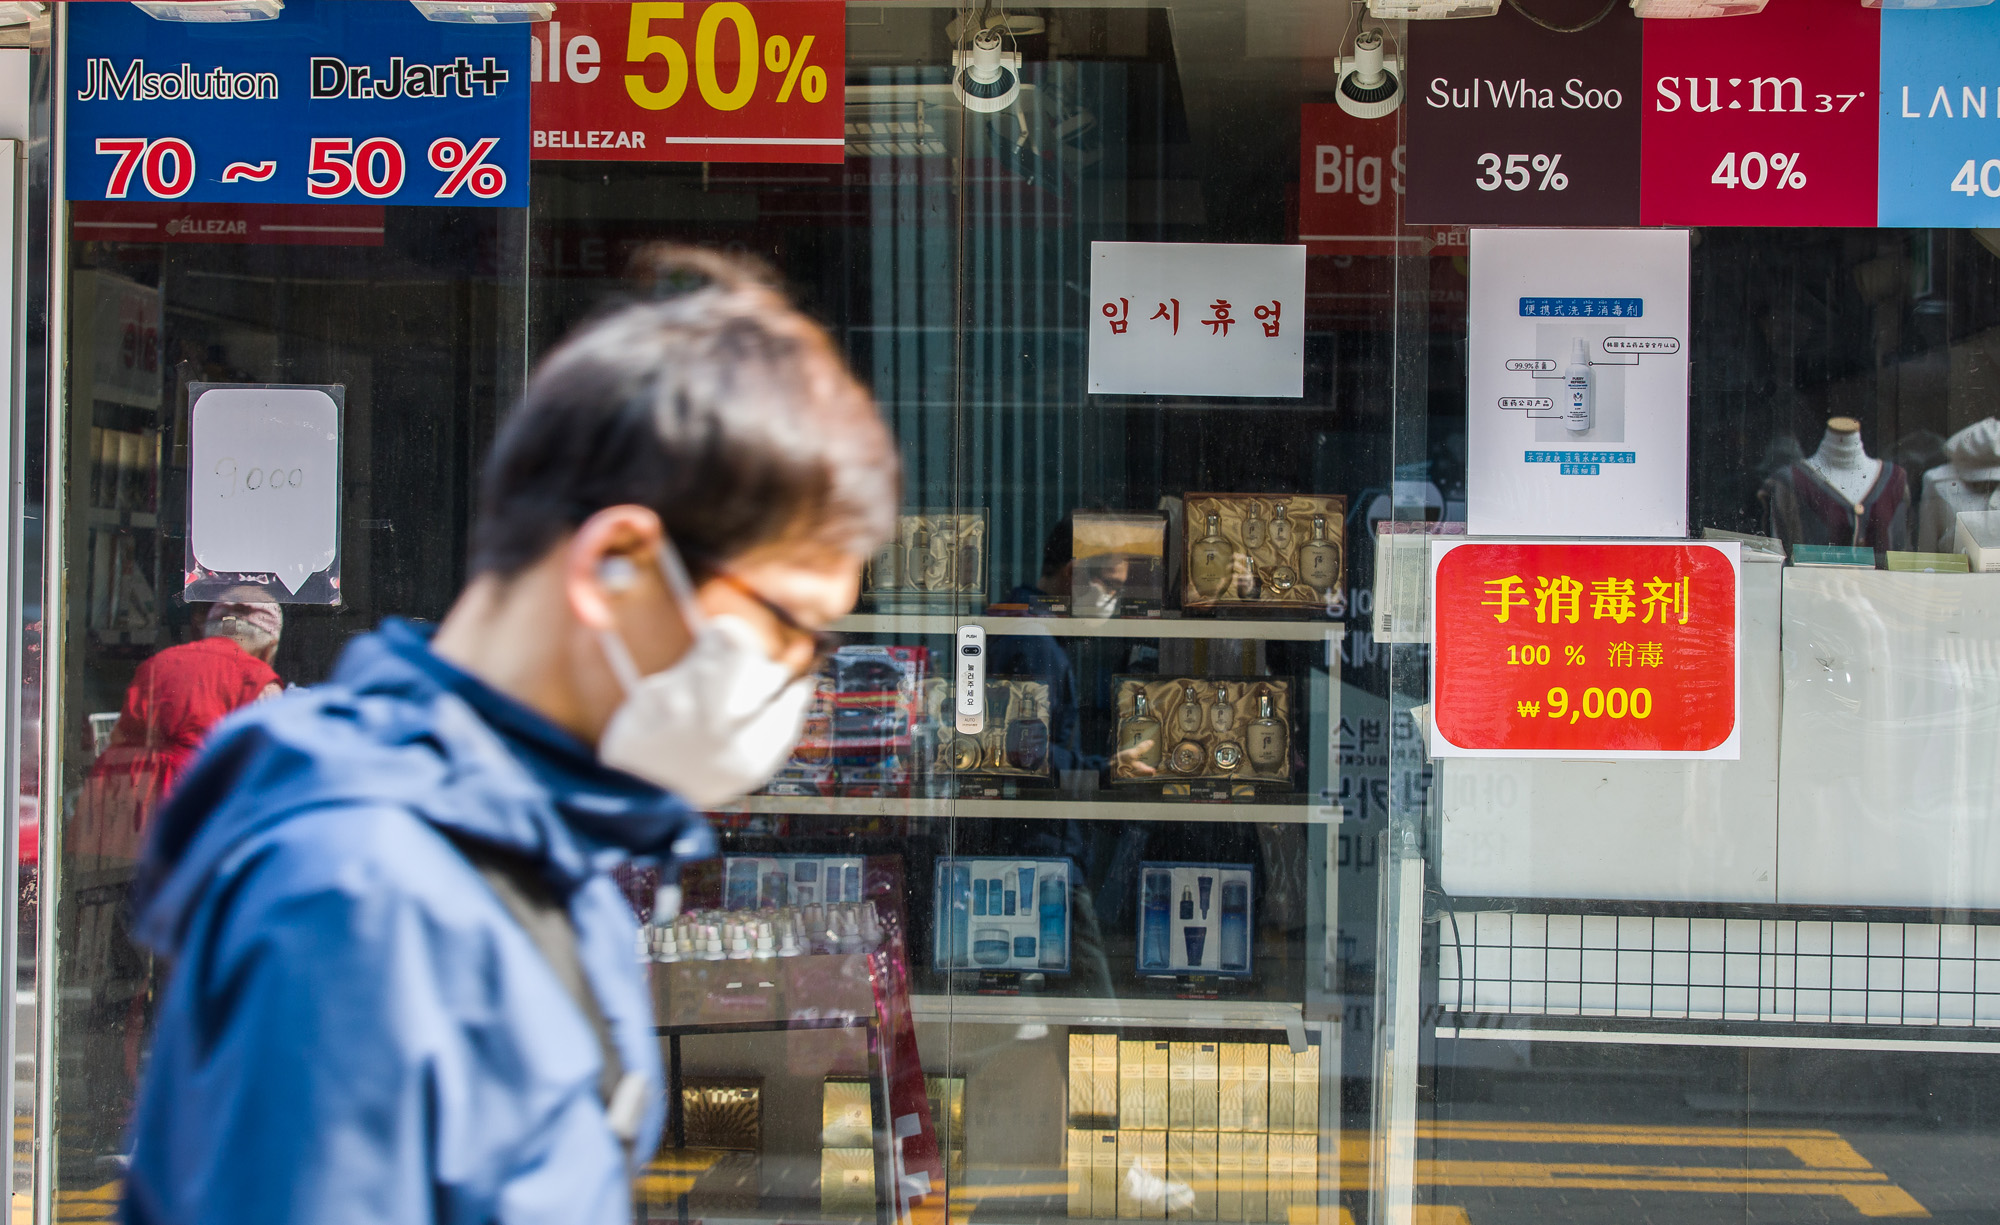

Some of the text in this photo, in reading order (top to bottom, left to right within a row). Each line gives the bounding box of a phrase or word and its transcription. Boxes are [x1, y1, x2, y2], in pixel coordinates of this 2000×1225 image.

[625, 2, 827, 111] 50%
[77, 56, 509, 102] JMsolution Dr.Jart+
[1426, 78, 1622, 110] Sul Wha Soo
[1656, 76, 1807, 113] su:m
[1902, 86, 2000, 119] LAN
[533, 130, 646, 149] BELLEZAR
[95, 137, 196, 199] 70
[307, 137, 405, 199] 50
[428, 137, 507, 199] %
[1315, 145, 1382, 205] Big
[1476, 153, 1569, 192] 35%
[1711, 152, 1807, 191] 40%
[1524, 304, 1639, 317] 便携式洗手消毒剂
[1502, 399, 1550, 407] 医药公司产品
[1480, 574, 1691, 626] 手消毒剂
[1507, 640, 1664, 668] 100 % 消毒
[967, 664, 975, 706] 눌러주세요
